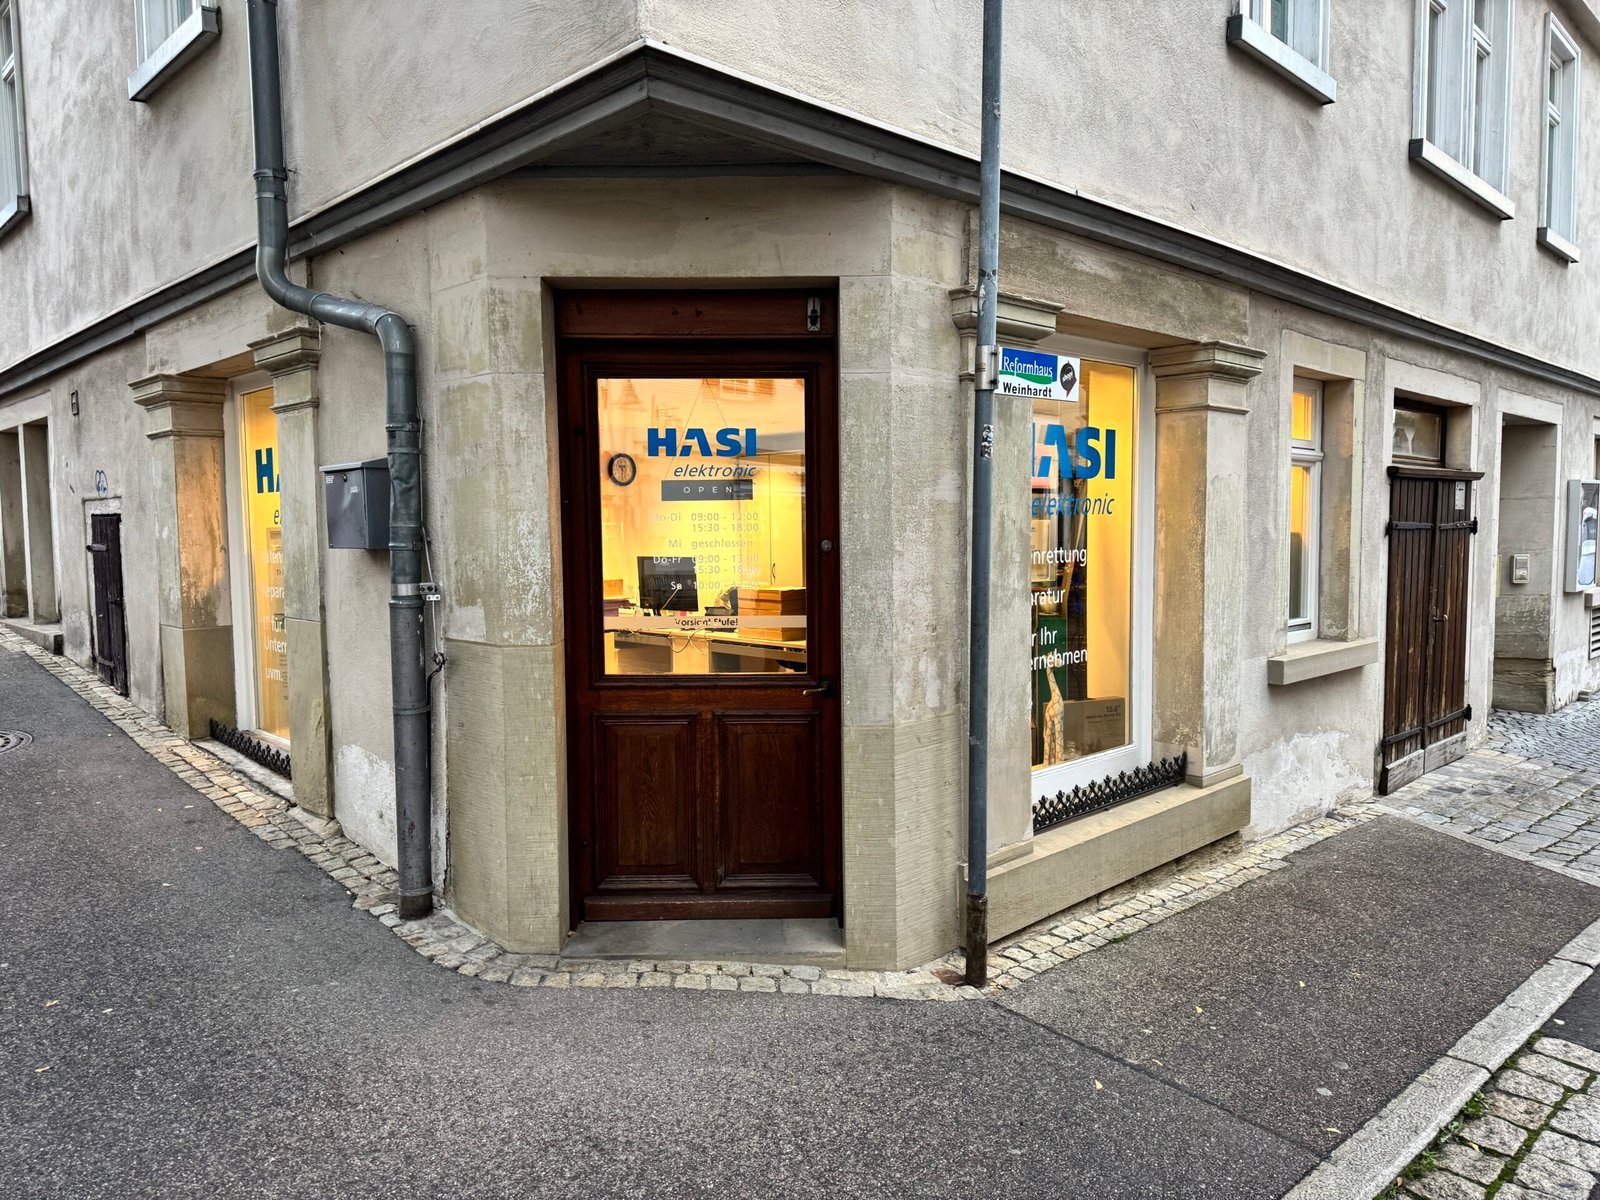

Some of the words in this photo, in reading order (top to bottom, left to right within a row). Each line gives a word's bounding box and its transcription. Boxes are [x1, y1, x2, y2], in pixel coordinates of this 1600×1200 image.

[1003, 356, 1053, 377] Reformhaus
[1003, 382, 1052, 398] Weinhardt
[647, 427, 757, 457] HASI
[1031, 422, 1116, 480] ASI
[255, 447, 280, 494] H
[673, 464, 757, 478] elektronic
[683, 486, 733, 494] OPEN
[1031, 491, 1115, 517] elektronic
[691, 512, 720, 522] 09:00
[692, 523, 720, 532] 15:30
[732, 523, 759, 532] 18:00
[668, 539, 682, 548] Mi
[691, 538, 753, 549] geschlossen
[653, 556, 682, 564] Do-Fr
[691, 555, 720, 563] 09:00
[670, 581, 682, 590] Sa
[1040, 626, 1057, 646] Ihr
[265, 666, 283, 682] uvm.
